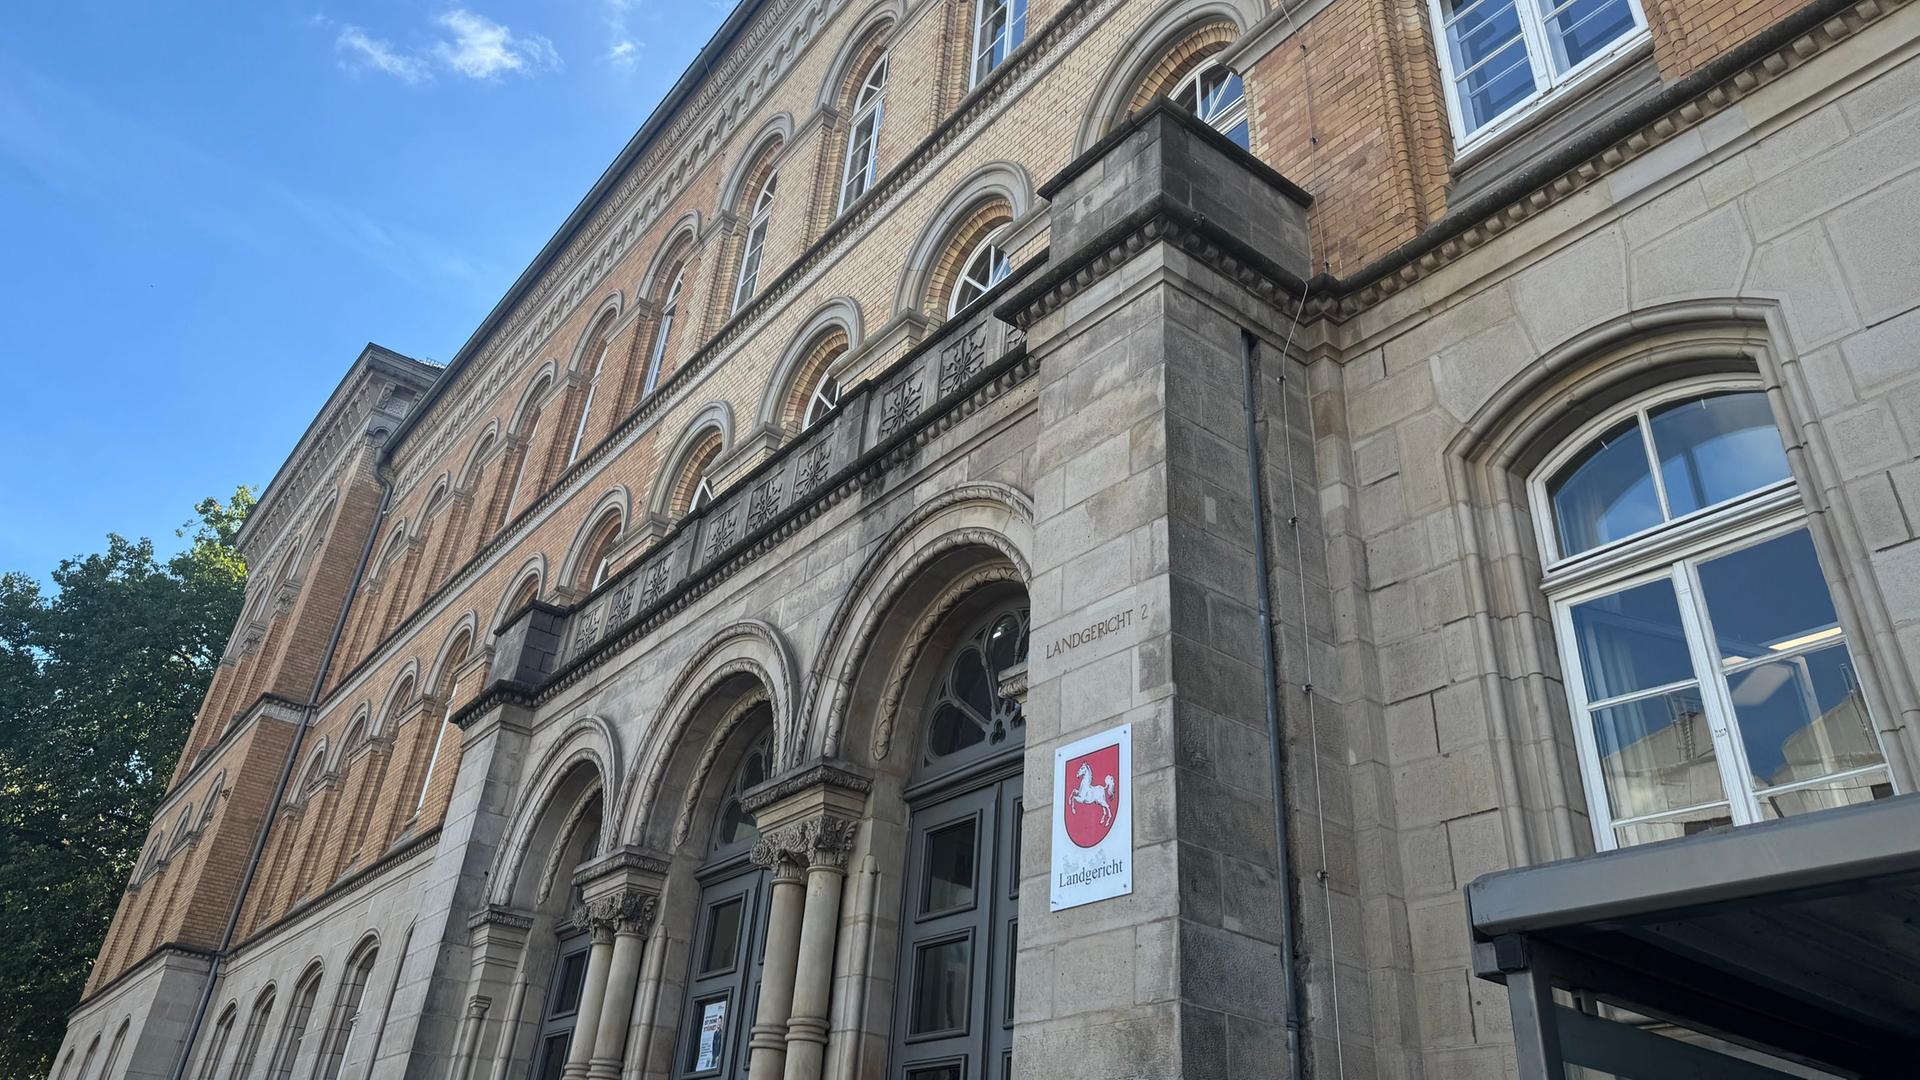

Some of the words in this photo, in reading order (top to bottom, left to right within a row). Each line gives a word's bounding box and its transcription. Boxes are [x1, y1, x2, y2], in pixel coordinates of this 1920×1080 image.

[1046, 609, 1133, 659] LANDGERICHT
[1140, 603, 1149, 620] 2
[1059, 859, 1123, 888] Landgericht
